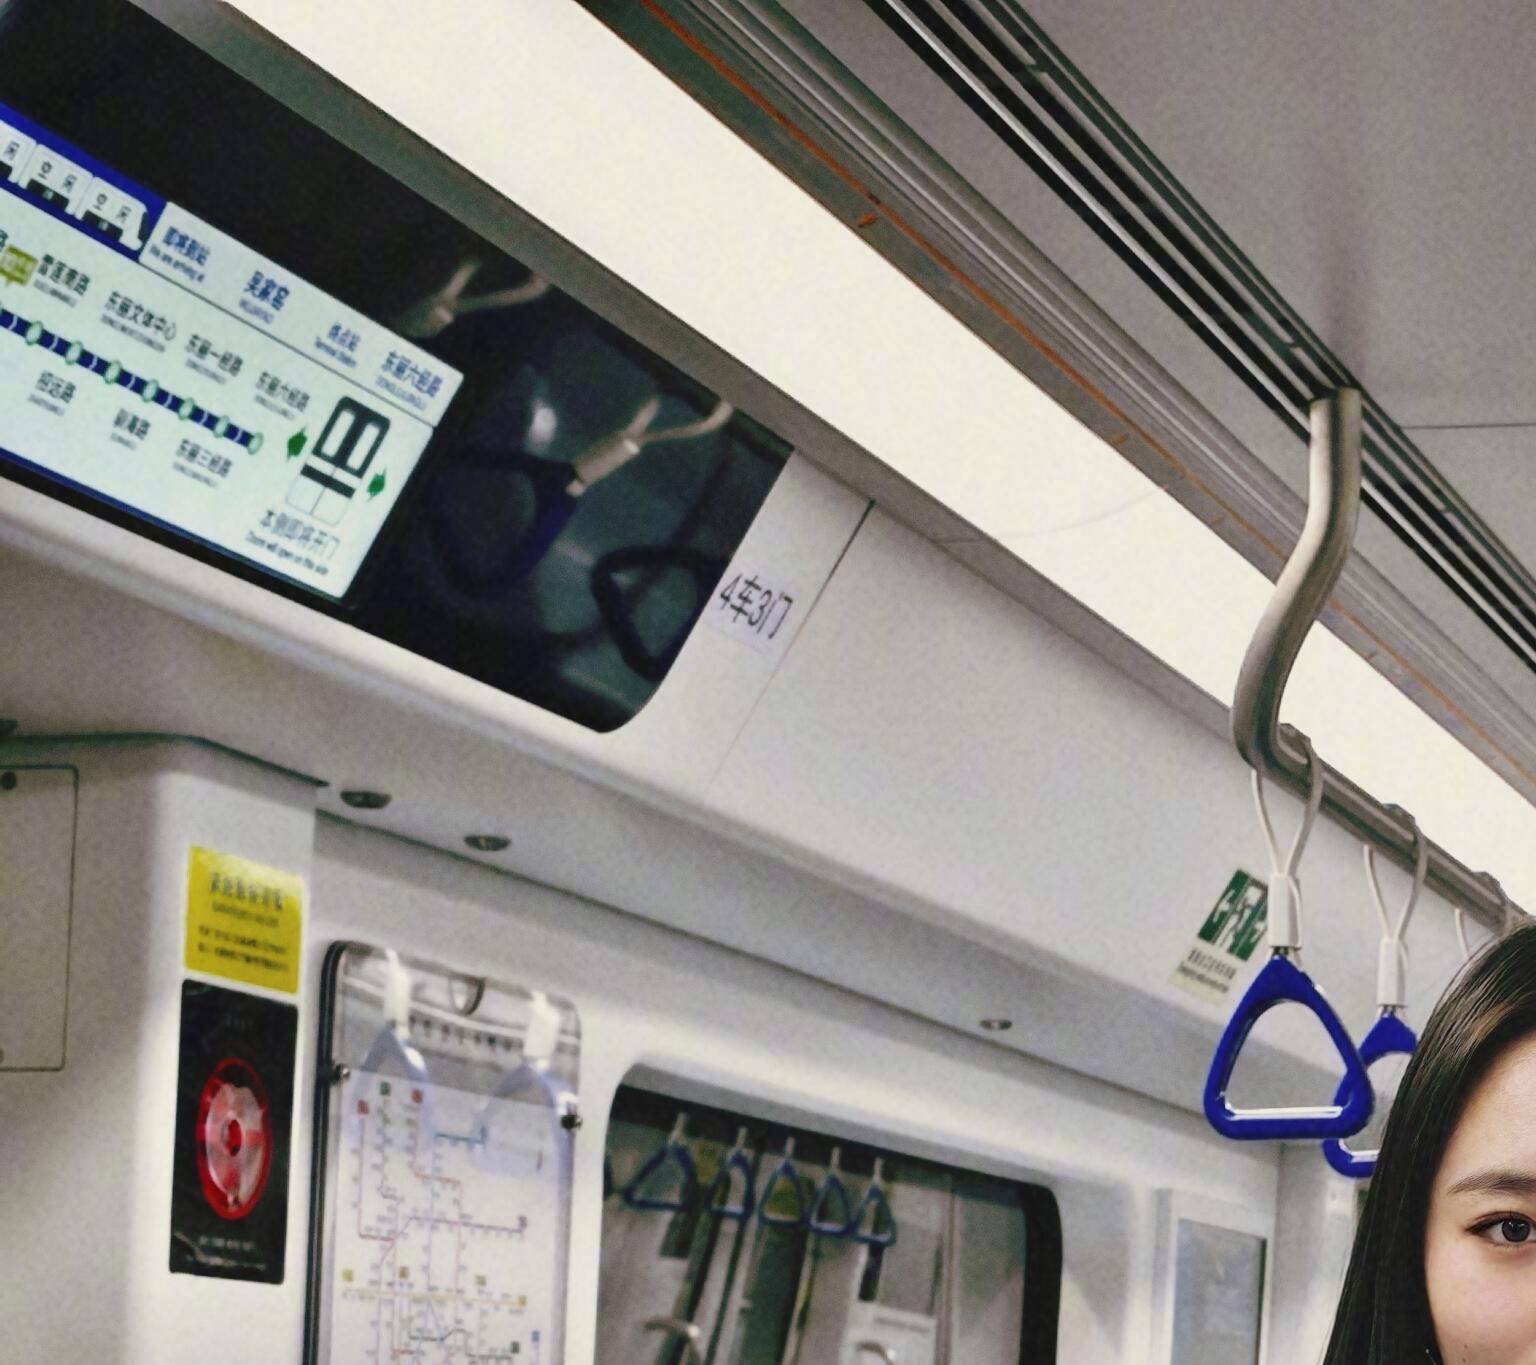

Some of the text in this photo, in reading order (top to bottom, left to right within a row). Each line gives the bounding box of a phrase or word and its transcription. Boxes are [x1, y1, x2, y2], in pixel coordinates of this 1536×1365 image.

[162, 225, 210, 266] 即将到站
[243, 269, 290, 312] 吴家窑
[105, 291, 177, 341] 东丽文体中心
[185, 333, 244, 378] 东丽一经路
[381, 350, 443, 398] 东丽六经路
[255, 371, 311, 413] 东丽六经路
[176, 438, 233, 479] 东丽三经路
[260, 509, 341, 561] 本侧即将开门
[720, 573, 793, 639] 4车3门
